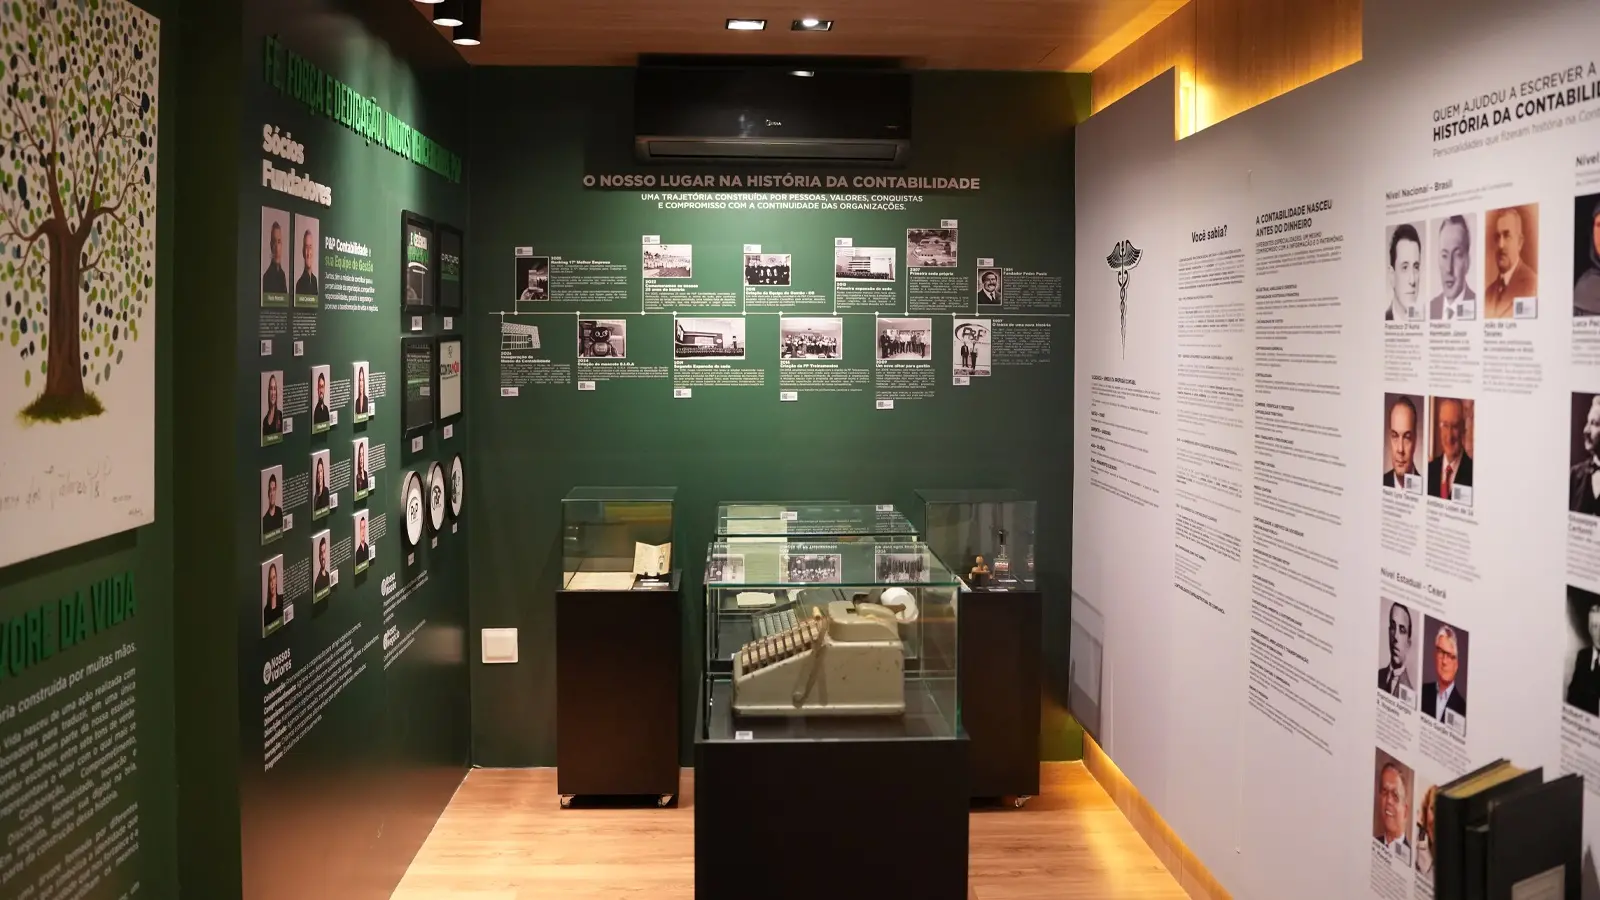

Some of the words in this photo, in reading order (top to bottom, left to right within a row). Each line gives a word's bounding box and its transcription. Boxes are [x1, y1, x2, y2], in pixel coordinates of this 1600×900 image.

[1433, 104, 1460, 122] QUEM
[1462, 89, 1506, 114] AJUDOU
[1509, 87, 1517, 100] A
[1520, 65, 1583, 97] ESCREVER
[1587, 62, 1597, 76] A
[385, 111, 410, 159] UNIDOS
[1433, 113, 1489, 142] HISTÓRIA
[1493, 107, 1511, 126] DA
[1433, 136, 1483, 158] Personalidades
[1485, 134, 1499, 148] que
[1500, 127, 1530, 144] fizeram
[1532, 116, 1563, 135] história
[1565, 115, 1576, 126] na
[262, 123, 304, 165] Sócios
[262, 158, 332, 206] Fundadores
[583, 176, 596, 188] O
[600, 175, 656, 188] NOSSO
[660, 175, 715, 188] LUGAR
[719, 175, 742, 188] NA
[746, 171, 822, 188] HISTÓRIA
[826, 176, 849, 189] DA
[852, 176, 981, 190] CONTABILIDADE
[1385, 188, 1401, 201] Nível
[1402, 184, 1429, 199] Nacional
[1434, 179, 1453, 193] Brasil
[641, 193, 660, 201] UMA
[661, 191, 713, 202] TRAJETÓRIA
[714, 191, 768, 202] CONSTRUÍDA
[769, 194, 788, 202] POR
[788, 194, 829, 204] PESSOAS,
[829, 194, 870, 204] VALORES,
[871, 195, 924, 203] CONQUISTAS
[665, 202, 728, 210] COMPROMISSO
[729, 202, 748, 210] COM
[749, 202, 757, 210] A
[757, 202, 820, 210] CONTINUIDADE
[839, 201, 908, 213] ORGANIZAÇÕES.
[1255, 215, 1261, 225] A
[1260, 205, 1306, 224] CONTABILIDADE
[1306, 199, 1333, 215] NASCEU
[1191, 229, 1206, 243] Você
[1207, 224, 1228, 240] sabia?
[1255, 225, 1274, 237] ANTES
[1274, 224, 1284, 234] DO
[1283, 217, 1313, 232] DINHEIRO
[325, 236, 336, 251] P&P
[336, 238, 368, 258] Contabilidade
[334, 254, 352, 271] Equipe
[352, 257, 358, 270] de
[358, 259, 374, 273] Gestão
[1380, 567, 1396, 580] Nível
[1396, 572, 1422, 590] Estadual
[1428, 584, 1447, 600] Ceará
[58, 592, 90, 651] DA
[90, 570, 138, 636] VIDA
[68, 668, 84, 689] por
[86, 653, 113, 676] muitas
[114, 642, 137, 661] mãos.
[270, 648, 291, 669] Nossos
[271, 659, 292, 682] Valores
[23, 718, 49, 738] nasceu
[50, 709, 60, 723] de
[61, 701, 76, 716] uma
[78, 691, 93, 706] ação
[95, 675, 122, 696] realizada
[123, 667, 136, 680] com
[42, 727, 58, 744] para
[91, 700, 102, 713] em
[104, 691, 118, 705] uma
[120, 680, 136, 696] única
[60, 729, 78, 748] parte
[80, 722, 90, 735] da
[91, 711, 109, 728] nossa
[94, 726, 108, 741] tons
[109, 719, 118, 731] de
[119, 708, 136, 724] verde
[77, 751, 92, 767] com
[99, 735, 113, 752] qual
[114, 727, 129, 742] mais
[129, 721, 137, 732] se
